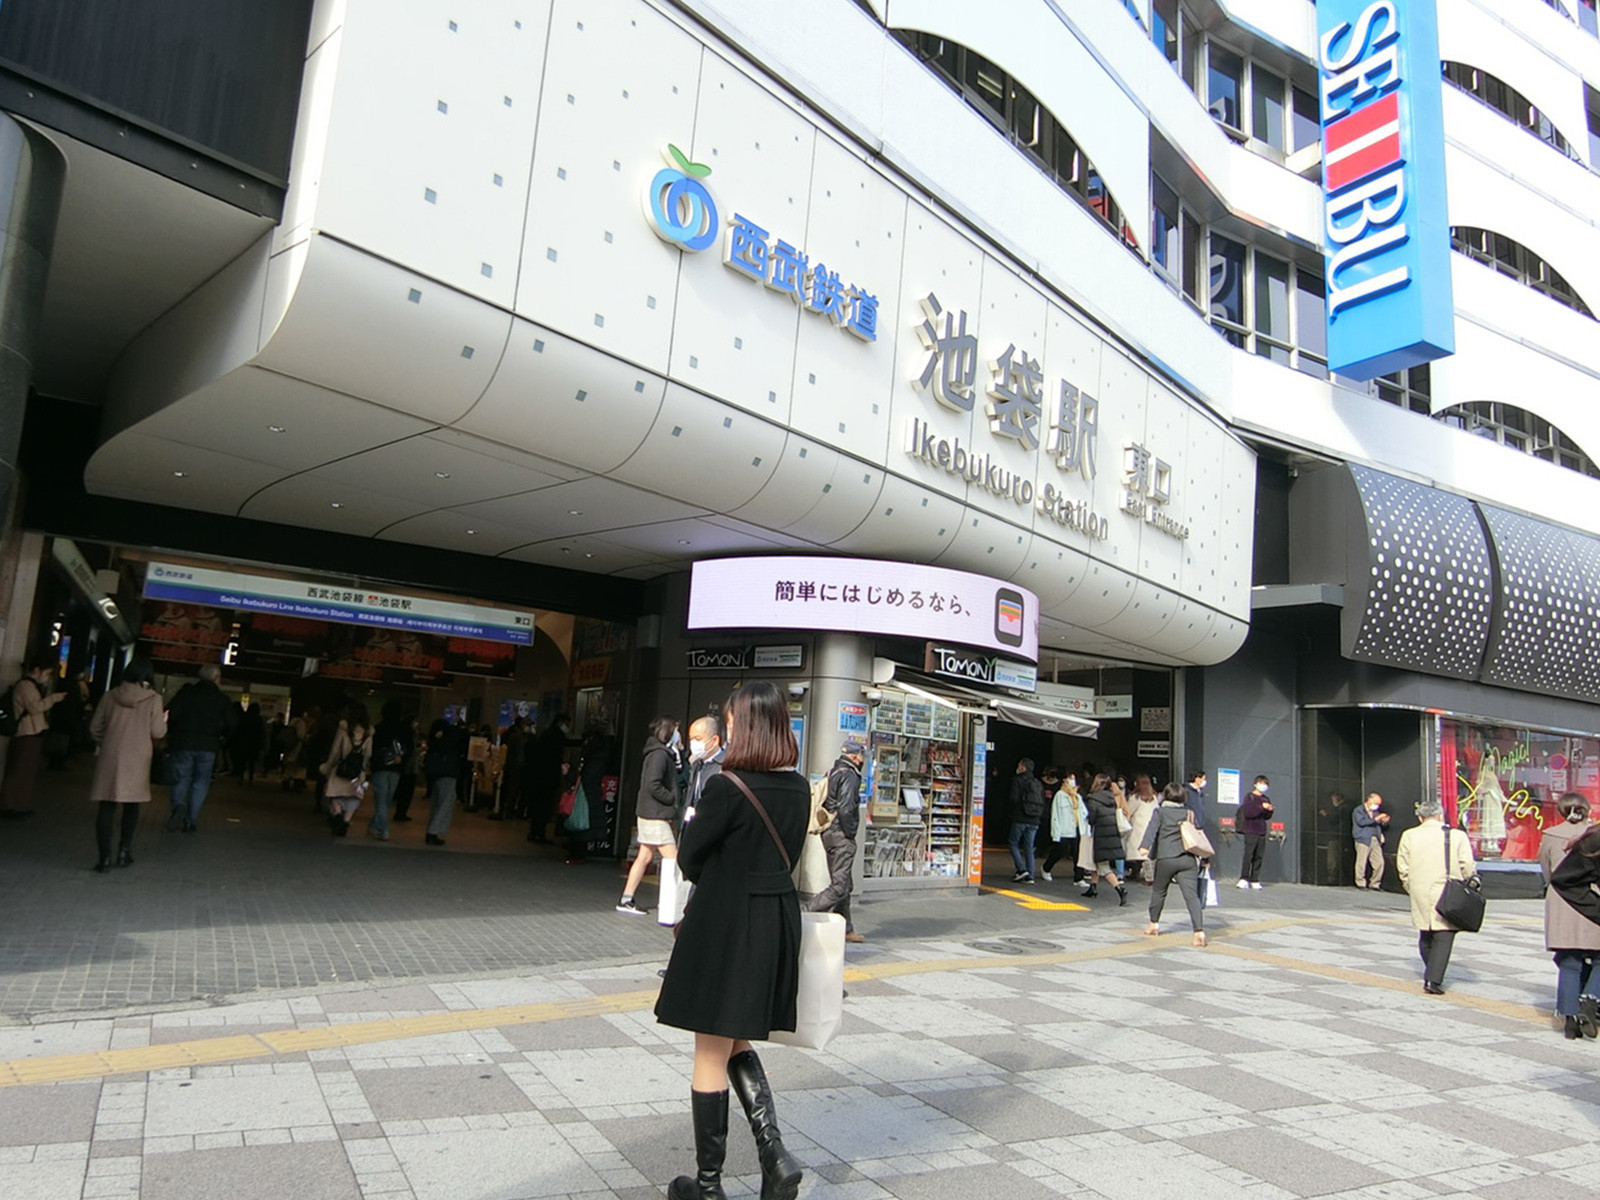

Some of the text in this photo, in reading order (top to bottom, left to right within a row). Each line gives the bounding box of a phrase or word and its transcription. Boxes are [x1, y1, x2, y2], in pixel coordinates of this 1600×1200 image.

[1320, 0, 1411, 318] SEIBU
[725, 212, 879, 342] 西武鉄道
[912, 292, 1172, 505] 池袋駅 東口
[907, 416, 1190, 540] Ikebukuro Station East Entrance
[220, 594, 241, 605] Seibu
[242, 598, 278, 610] Ikebukuro
[279, 603, 294, 611] Line
[295, 605, 329, 616] Ikebukuro
[330, 609, 354, 619] Station
[307, 586, 365, 604] 西武池袋線
[379, 596, 412, 610] 池袋駅
[774, 579, 972, 618] 簡単にはじめるなら、
[686, 645, 753, 669] TOMONY
[934, 647, 998, 684] TOMONY
